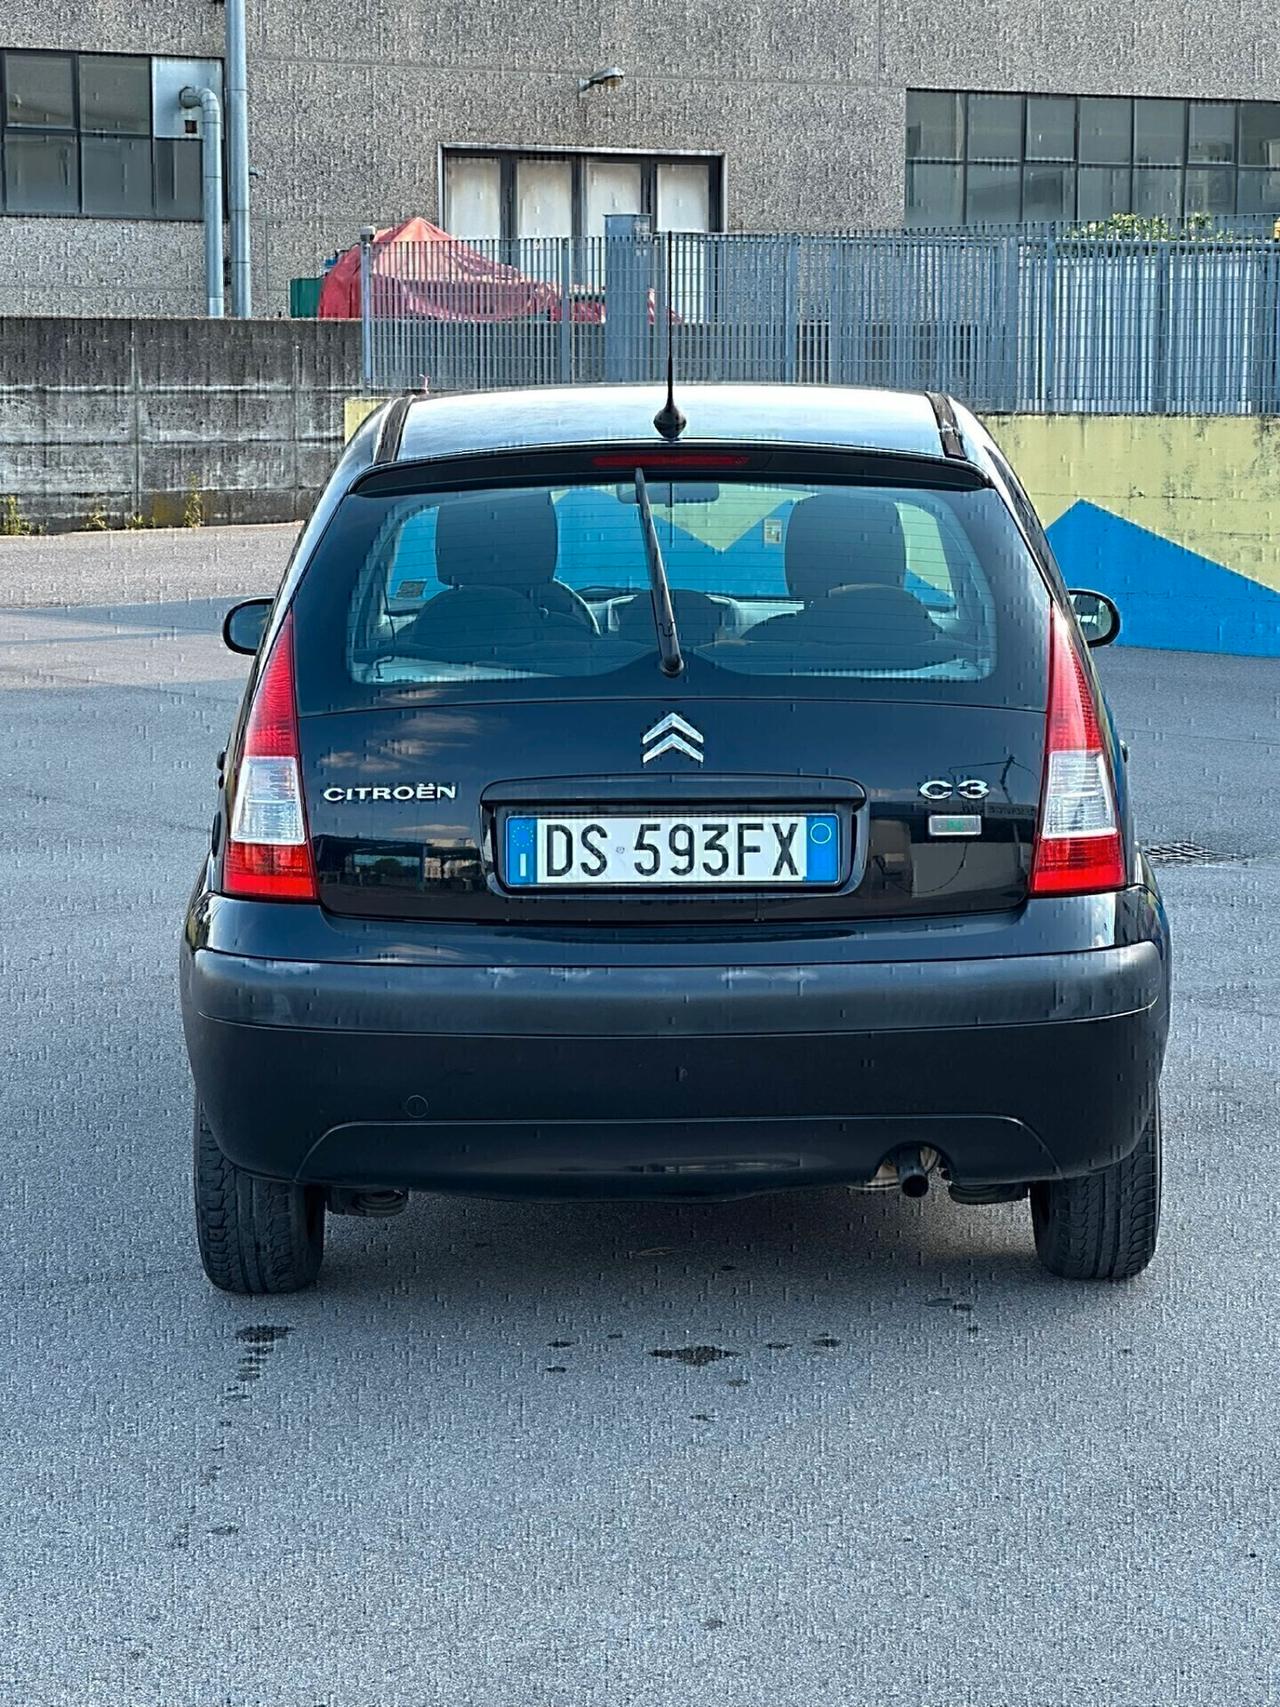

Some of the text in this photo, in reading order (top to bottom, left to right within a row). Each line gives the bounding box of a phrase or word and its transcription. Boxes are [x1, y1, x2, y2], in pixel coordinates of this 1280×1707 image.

[323, 783, 456, 801] CITROËN
[920, 780, 990, 799] C3
[546, 823, 799, 877] DS 593FX
